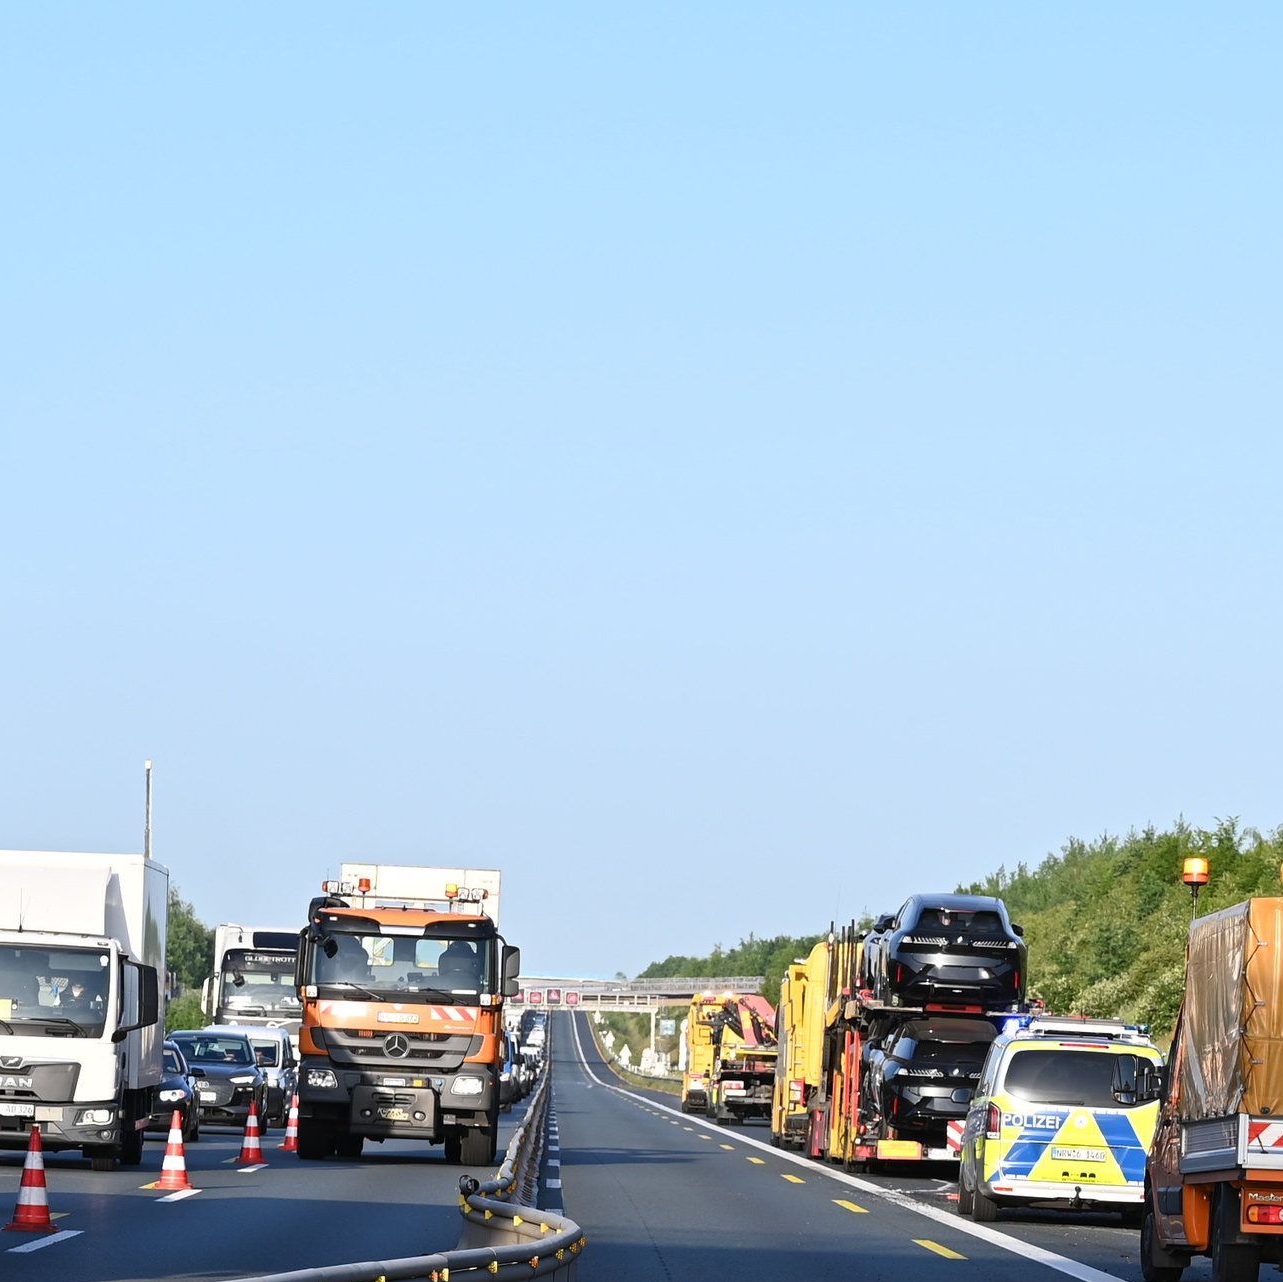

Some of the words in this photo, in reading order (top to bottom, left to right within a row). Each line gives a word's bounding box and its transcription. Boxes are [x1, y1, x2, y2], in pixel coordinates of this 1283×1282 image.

[245, 955, 296, 964] GLOBETROTT
[1002, 1112, 1061, 1129] POLIZEI
[1056, 1147, 1072, 1158] NRW
